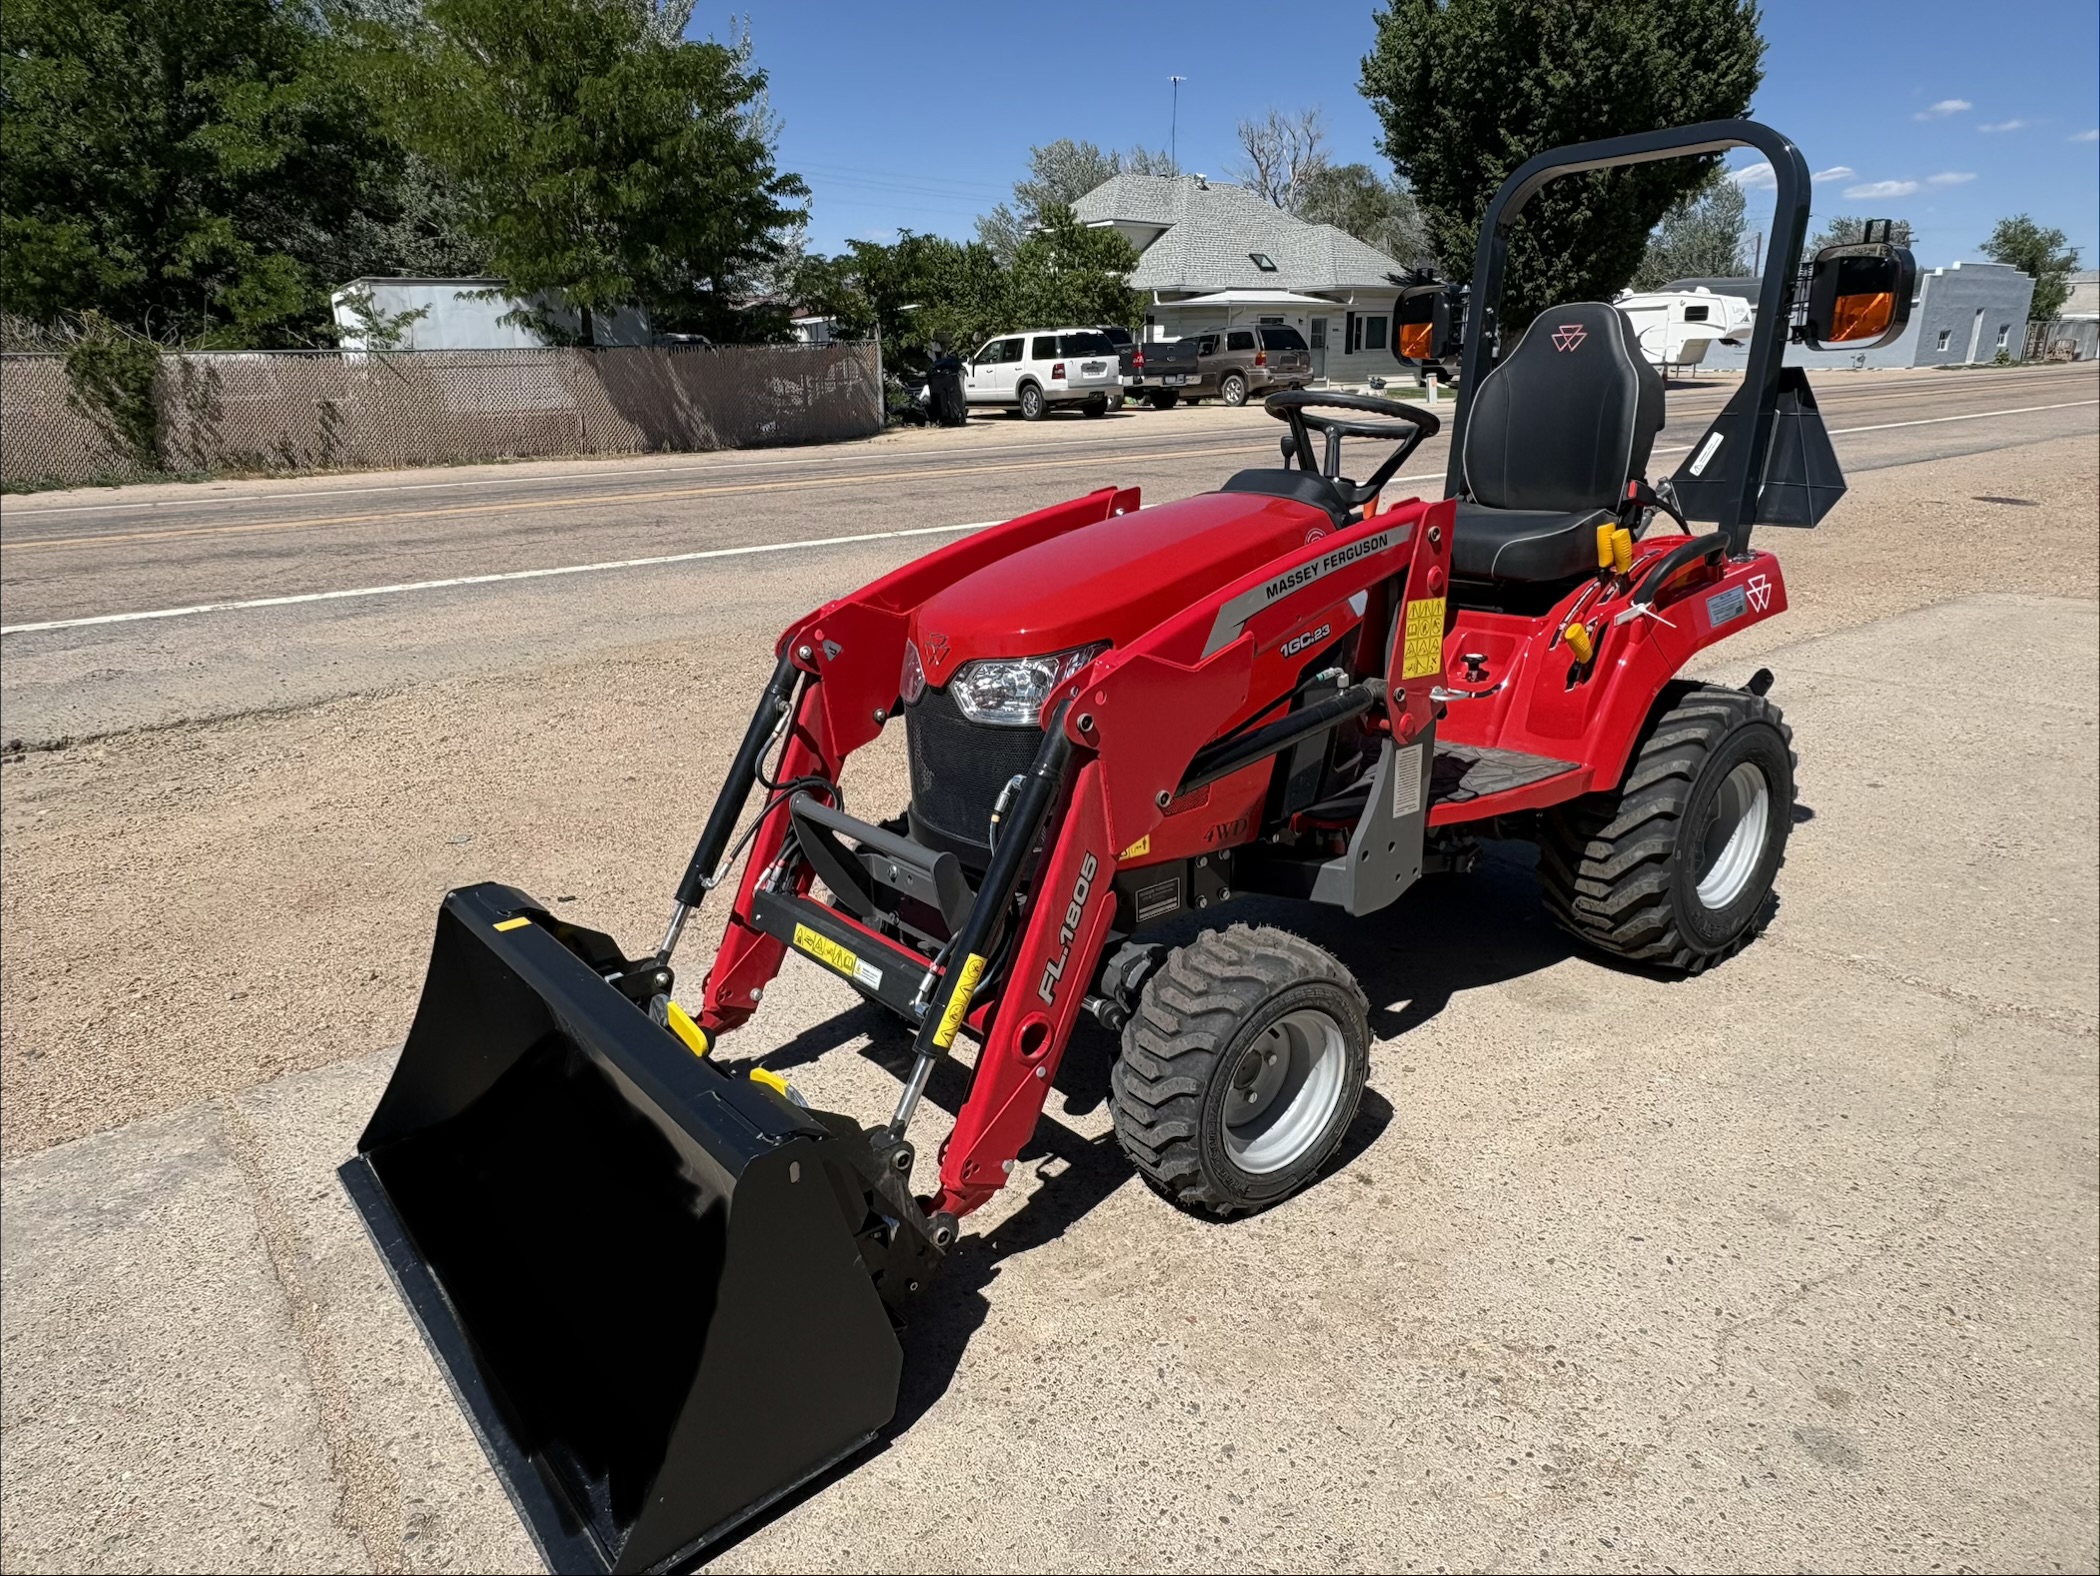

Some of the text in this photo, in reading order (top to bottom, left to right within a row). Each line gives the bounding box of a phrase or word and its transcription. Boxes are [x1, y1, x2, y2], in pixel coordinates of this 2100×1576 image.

[1266, 533, 1388, 599] MASSEY FERGUSON
[1203, 818, 1248, 843] 4WD
[1038, 851, 1097, 1005] FL.1805
